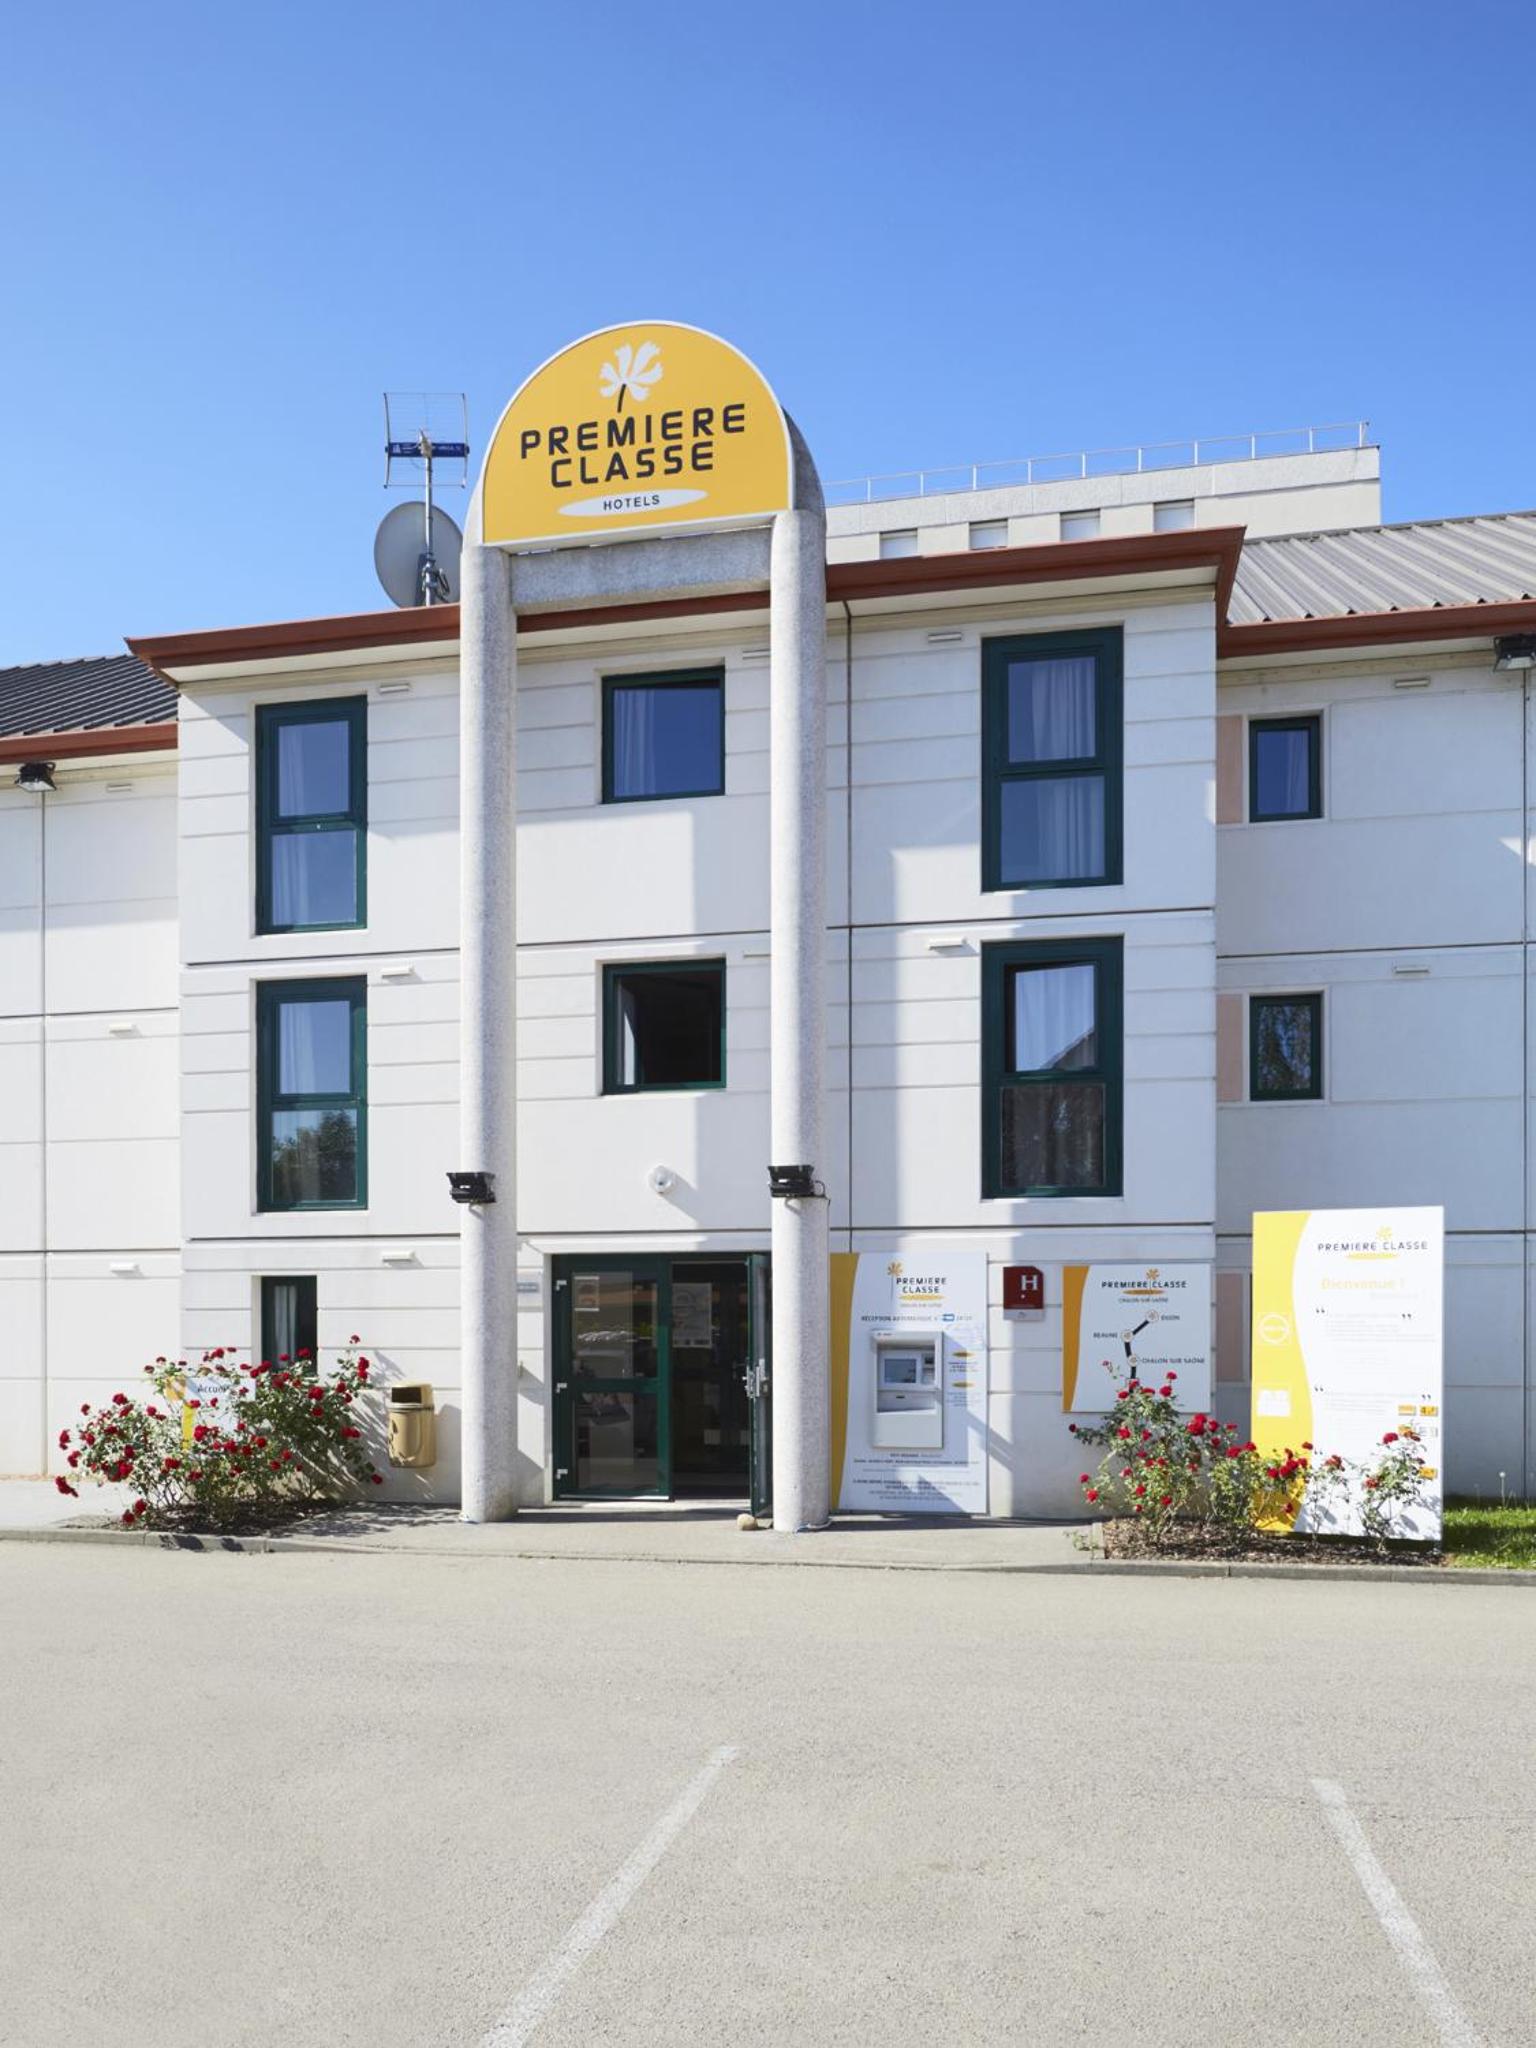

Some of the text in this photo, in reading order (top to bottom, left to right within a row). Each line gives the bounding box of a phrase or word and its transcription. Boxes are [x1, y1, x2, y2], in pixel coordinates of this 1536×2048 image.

[520, 403, 746, 459] PREMIERE
[551, 441, 713, 488] CLASSE
[603, 494, 661, 511] HOTELS
[1317, 1241, 1428, 1251] PREMIERE CLASSE
[896, 1277, 947, 1285] PREMIERE
[1021, 1274, 1038, 1291] H
[1101, 1280, 1187, 1289] PREMIERE CLASSE
[902, 1286, 940, 1294] CLASSE
